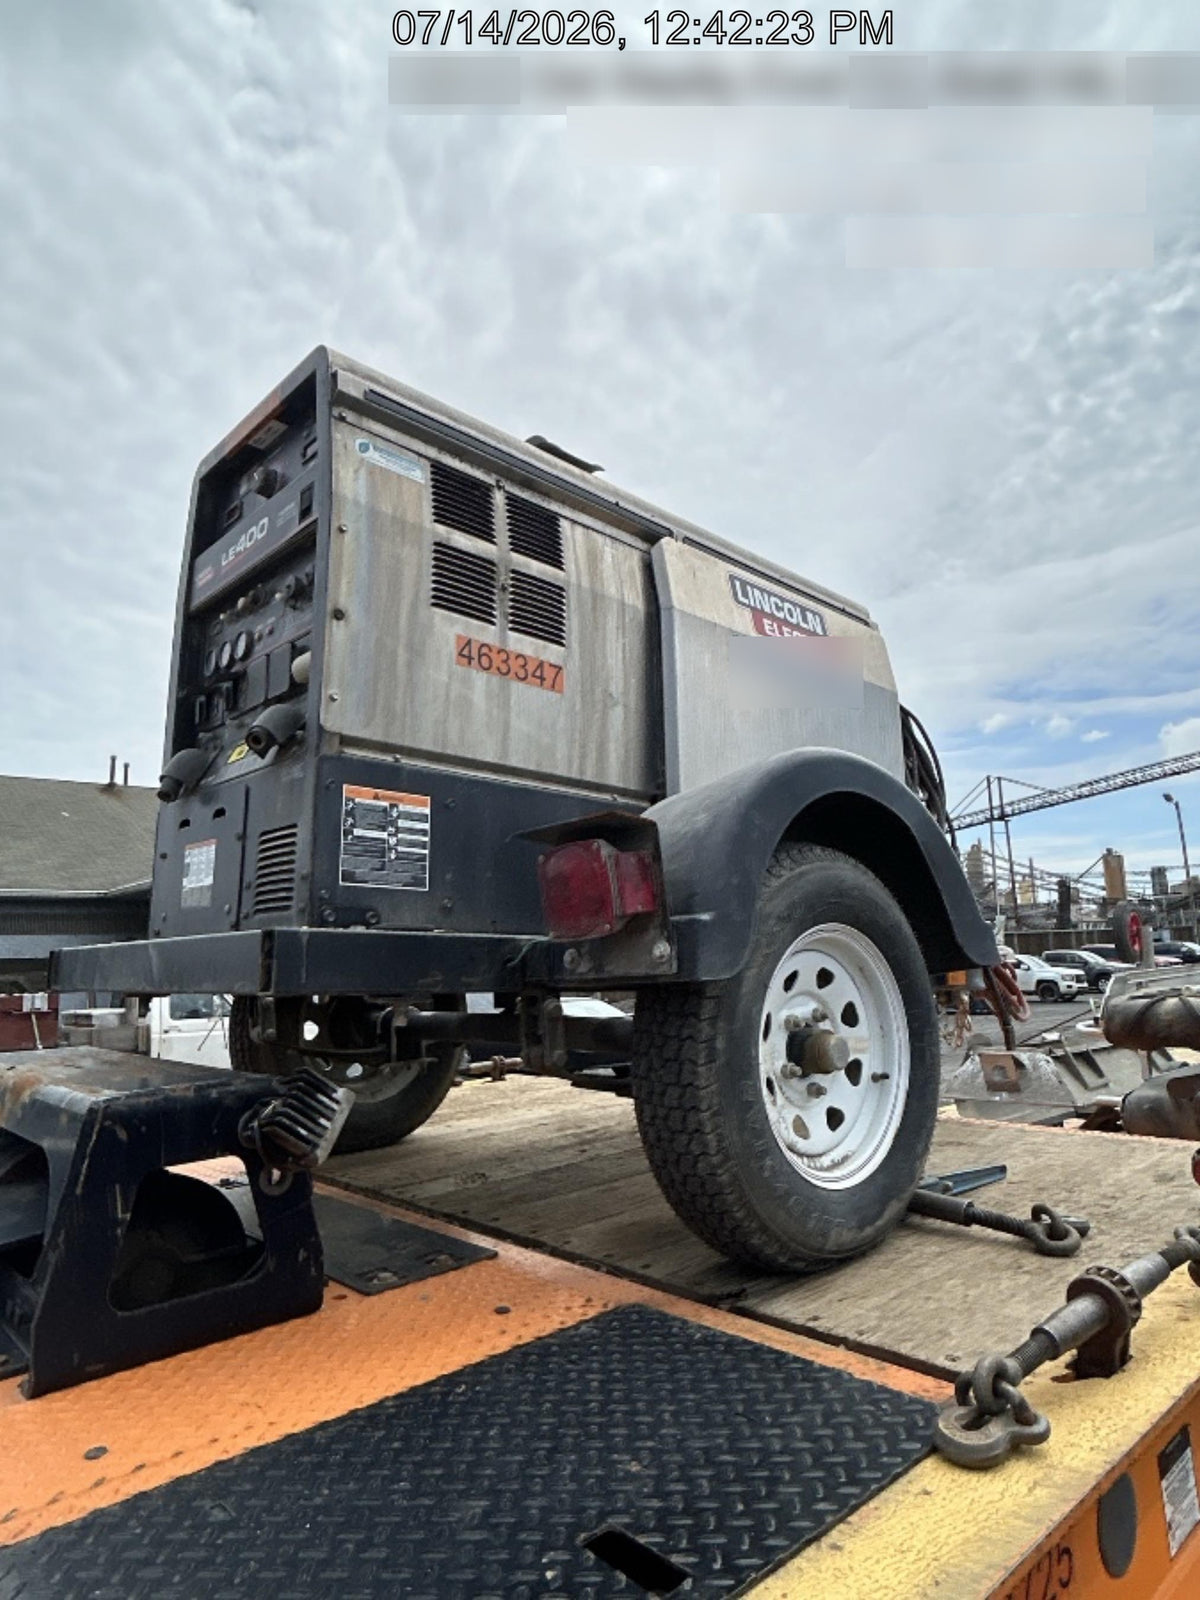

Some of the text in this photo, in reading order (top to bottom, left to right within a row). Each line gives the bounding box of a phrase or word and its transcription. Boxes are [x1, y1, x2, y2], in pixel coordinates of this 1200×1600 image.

[221, 517, 269, 566] LE400
[733, 579, 824, 636] LINCOLN
[457, 638, 562, 689] 463347
